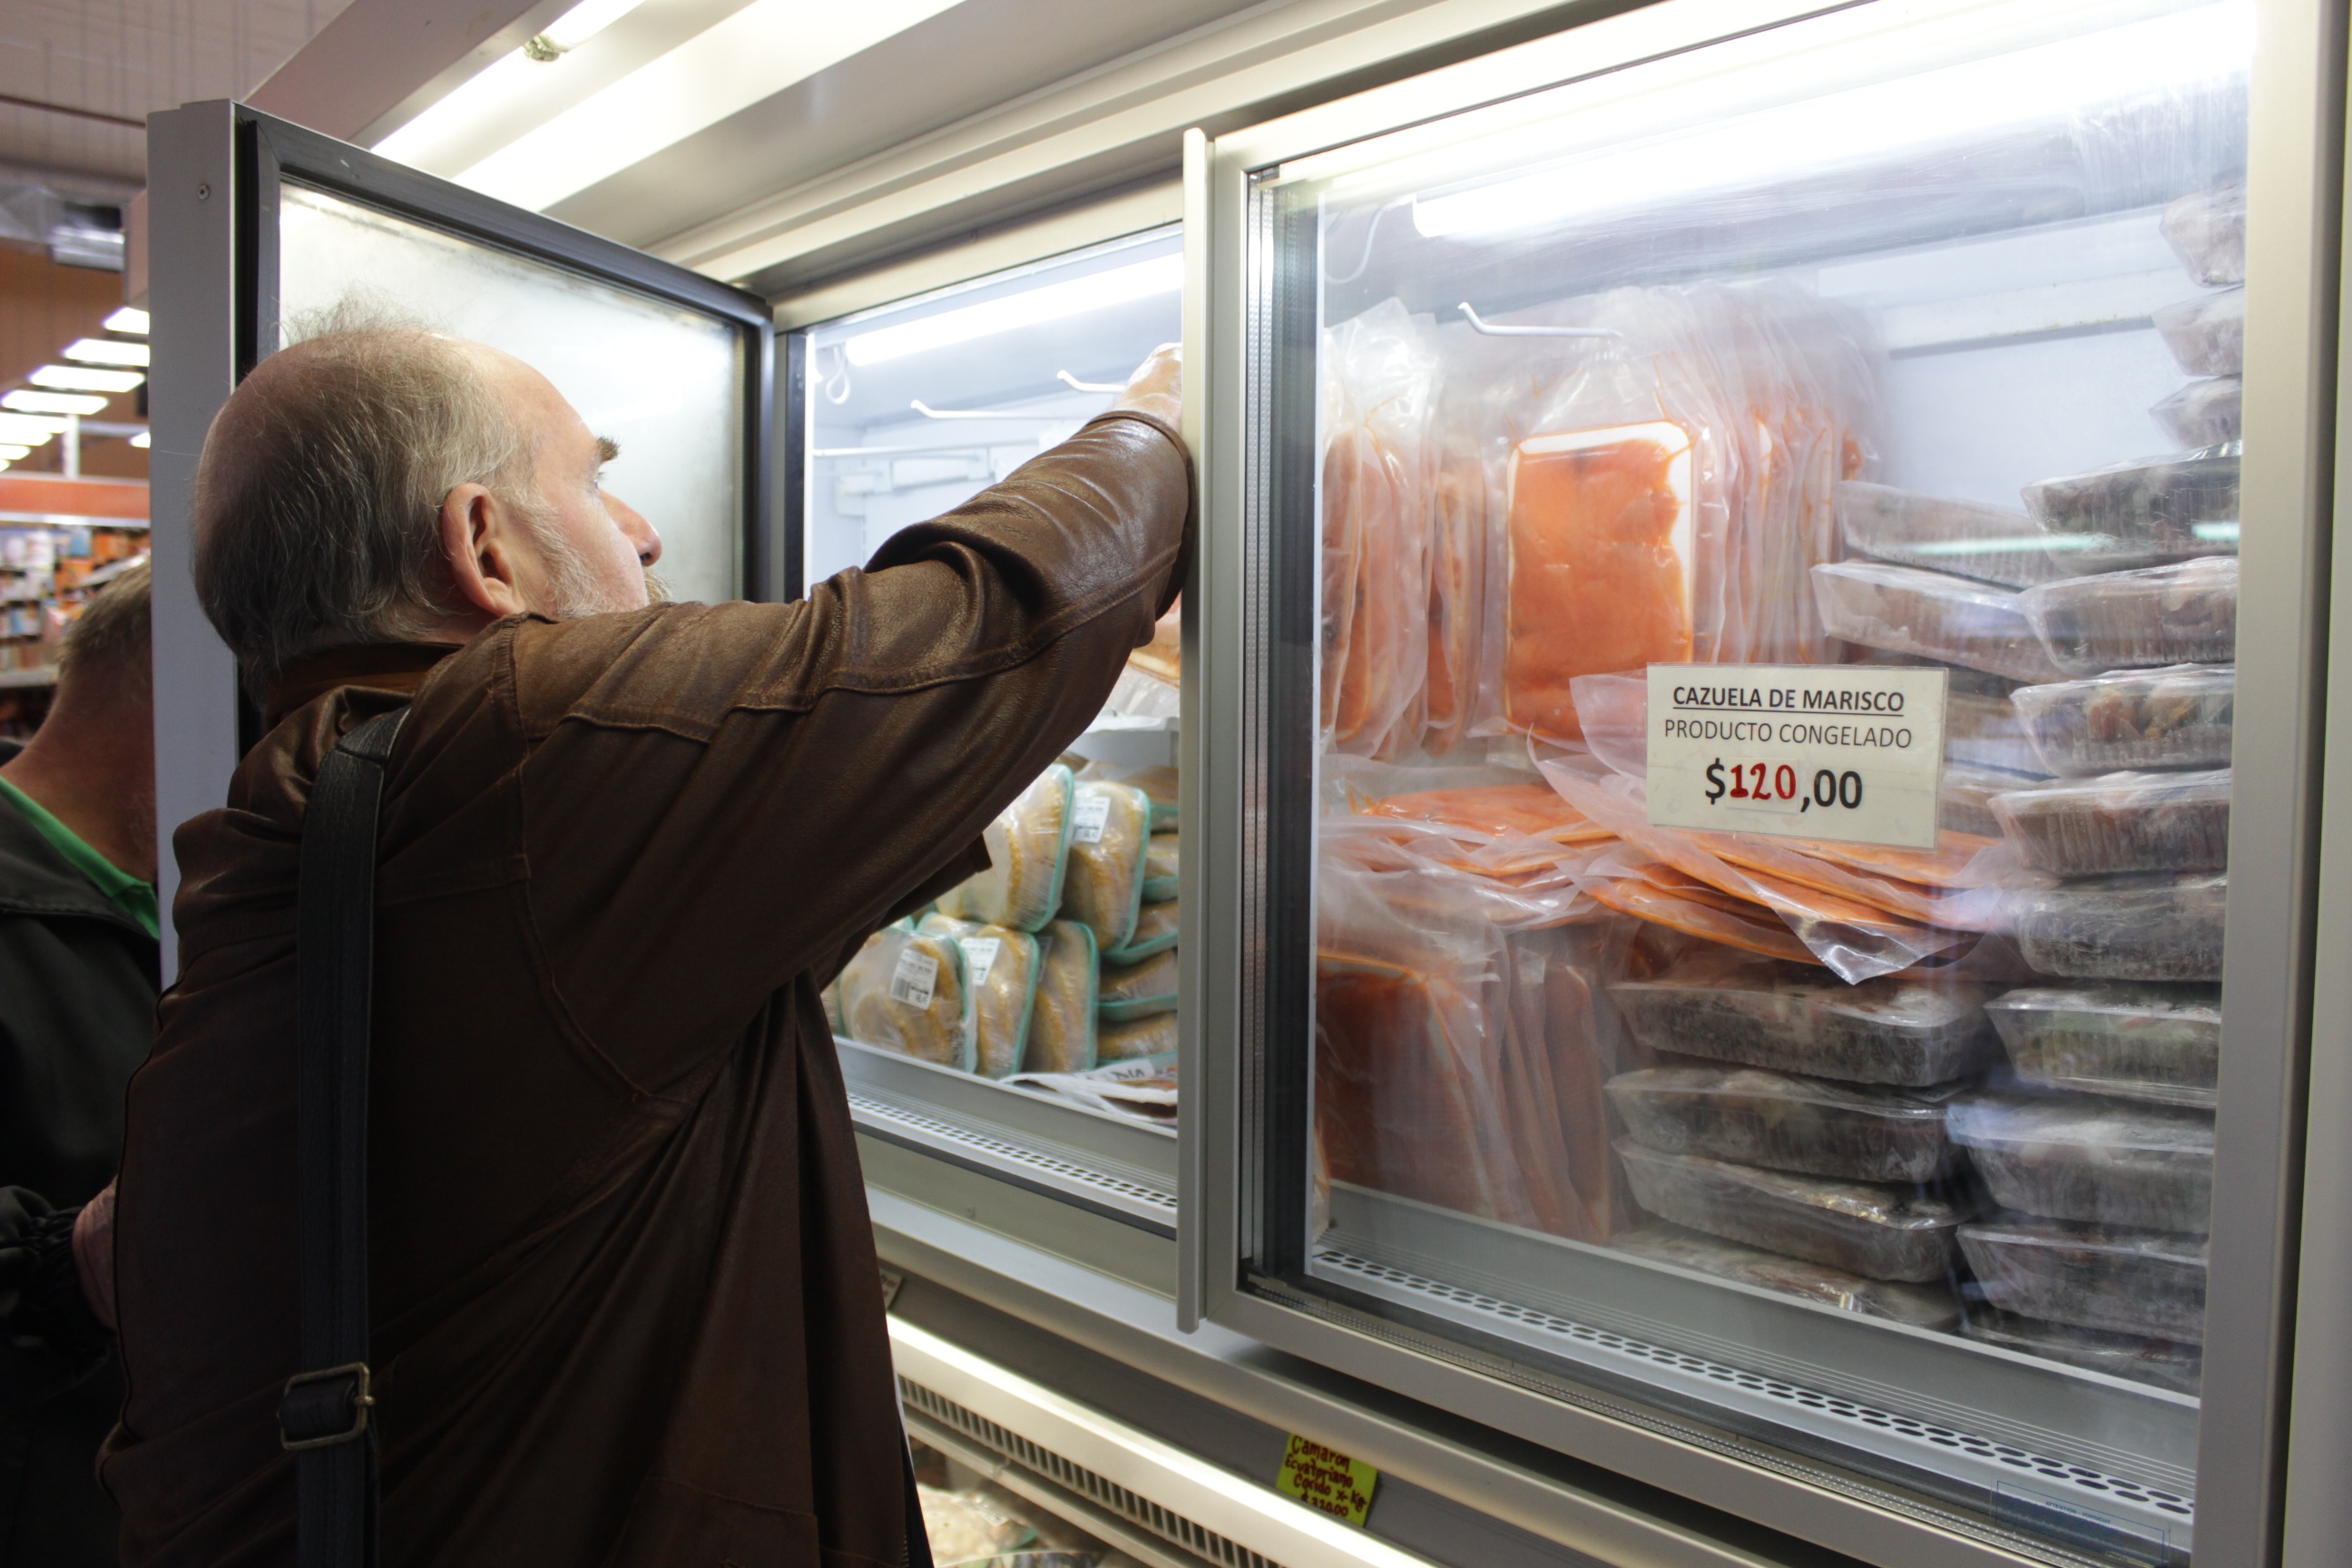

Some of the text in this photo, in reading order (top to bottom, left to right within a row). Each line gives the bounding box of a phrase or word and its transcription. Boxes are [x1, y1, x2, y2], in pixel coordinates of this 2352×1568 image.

[1673, 686, 1904, 712] CAZUELA DE MARISCO
[1664, 720, 1912, 749] PRODUCTO CONGELADO
[1705, 758, 1862, 813] $120,00
[2045, 1501, 2076, 1514] ATTENTION
[2082, 1512, 2111, 1524] VORSICHT
